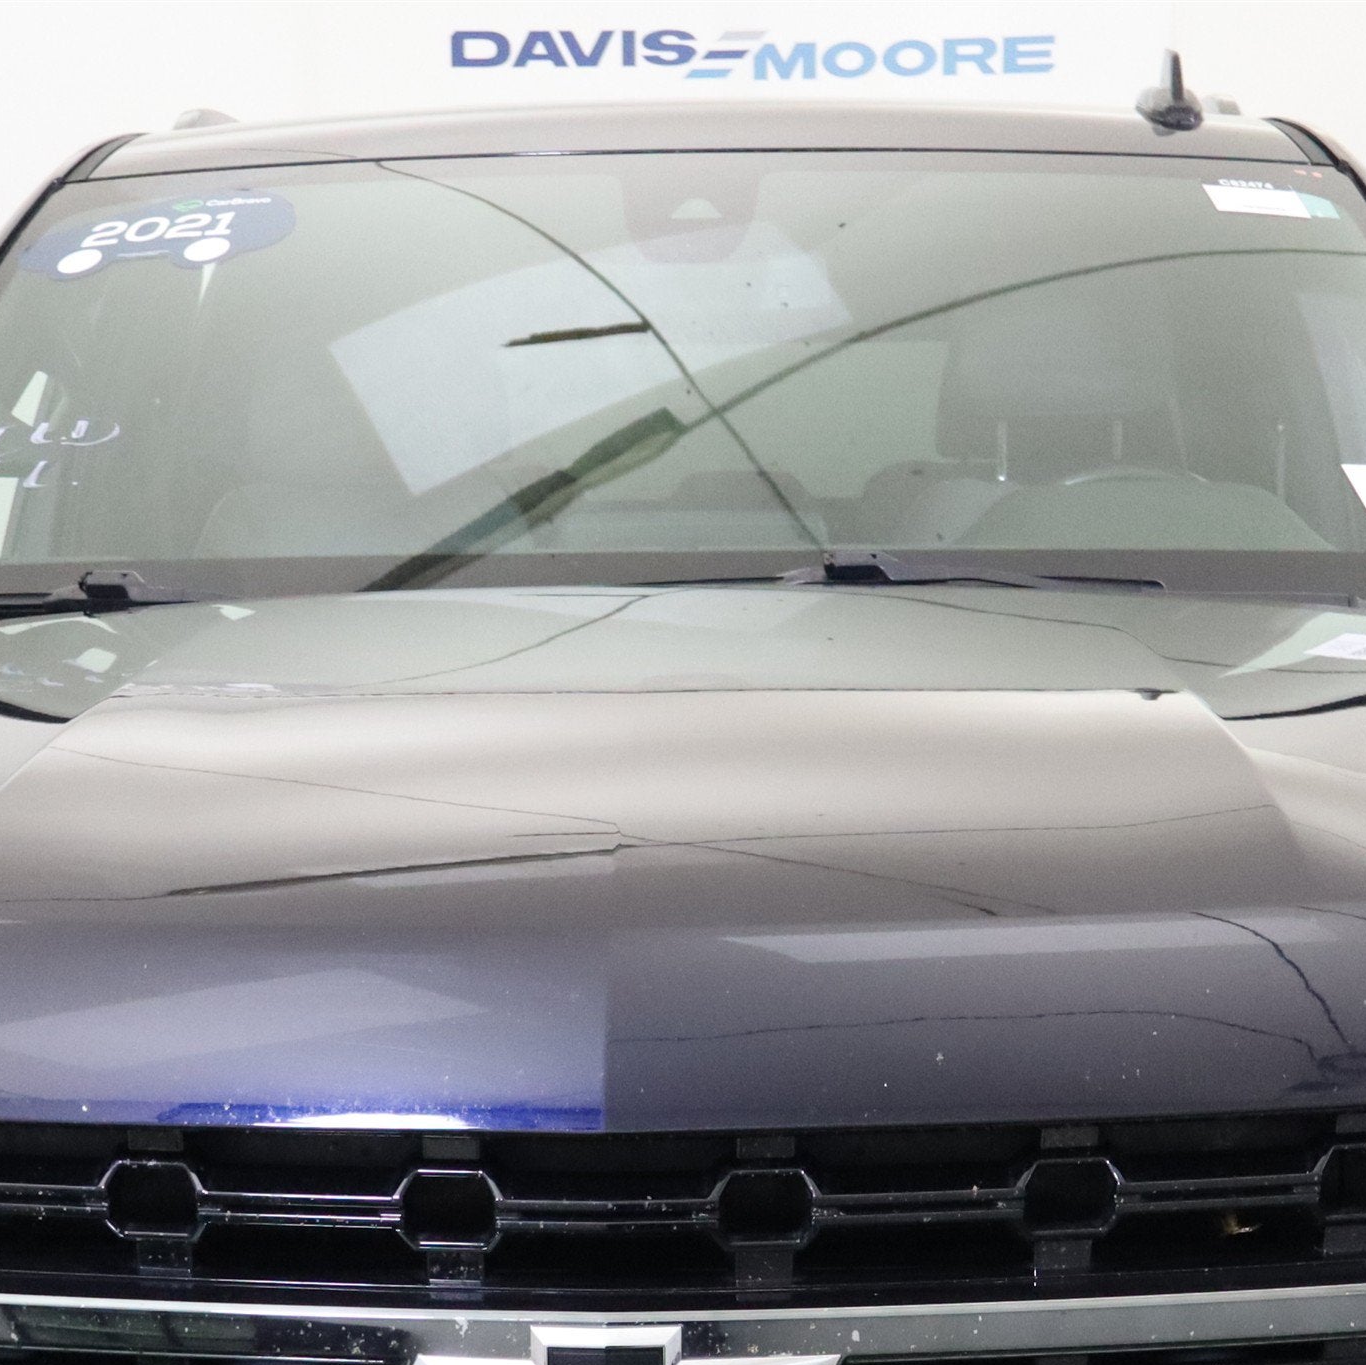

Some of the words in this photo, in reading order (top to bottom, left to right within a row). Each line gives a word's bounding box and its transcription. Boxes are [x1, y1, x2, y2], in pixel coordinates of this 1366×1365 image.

[451, 29, 697, 68] DAVIS
[753, 35, 1056, 80] MOORE
[80, 211, 235, 248] 2021
